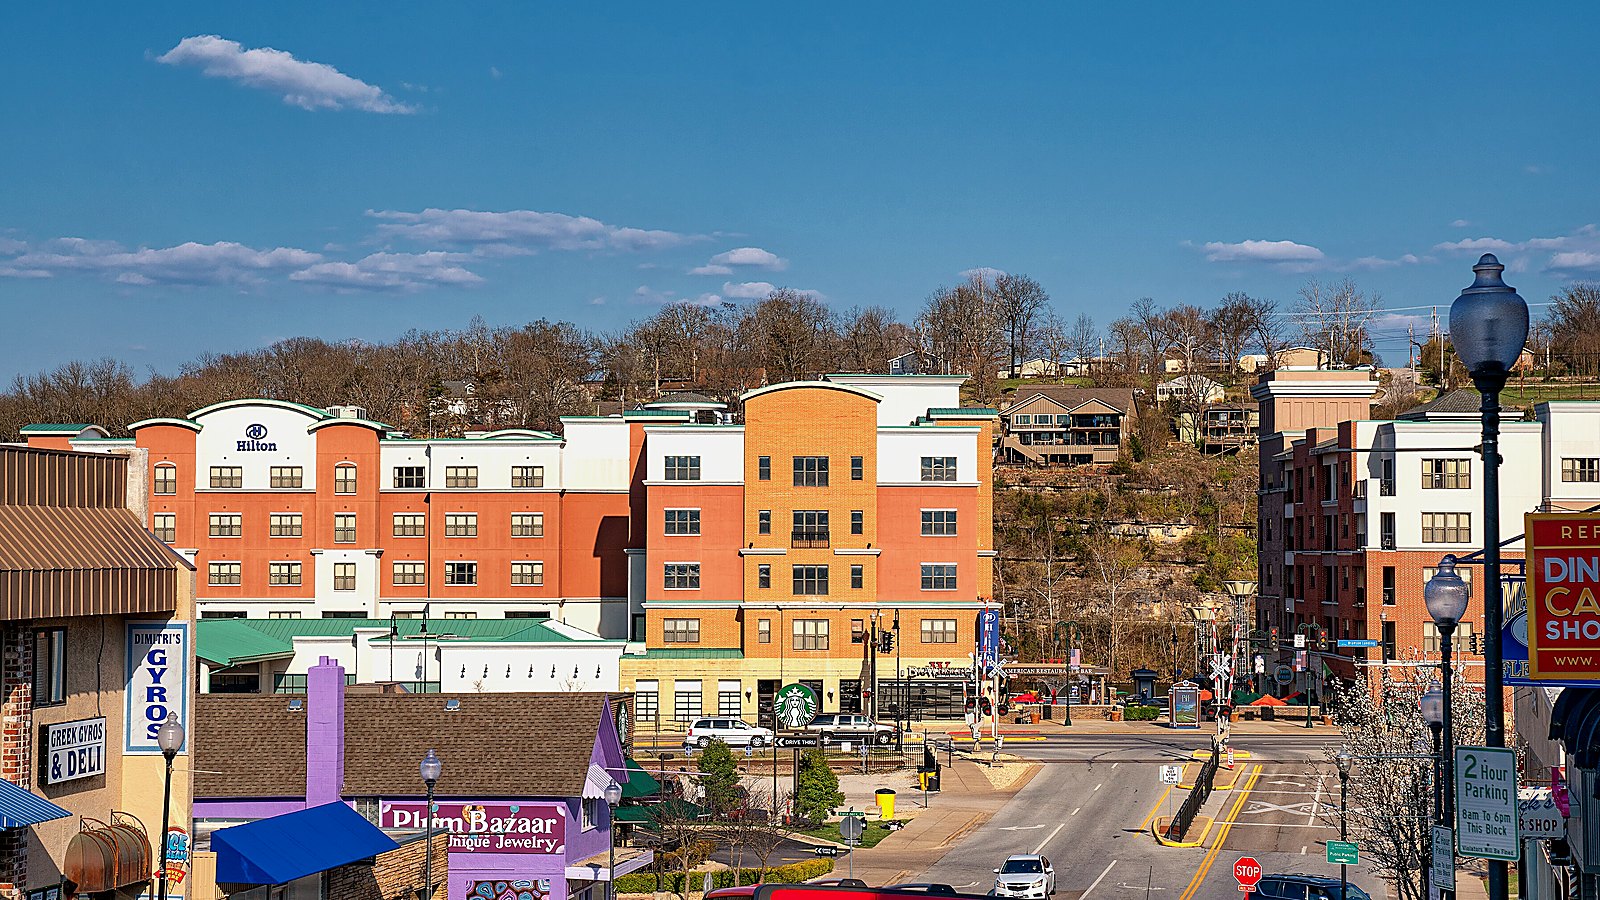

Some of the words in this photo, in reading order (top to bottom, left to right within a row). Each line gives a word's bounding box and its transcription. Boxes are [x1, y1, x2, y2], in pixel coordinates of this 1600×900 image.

[237, 440, 277, 451] Hilton
[1544, 557, 1599, 583] DIN
[1545, 587, 1600, 617] CA
[134, 633, 181, 645] DIMITRI'S
[1545, 620, 1600, 640] SHO
[146, 648, 168, 740] GYROS
[51, 727, 77, 747] GREEK
[78, 723, 103, 742] GYROS
[51, 753, 62, 780] &
[67, 746, 101, 777] DELI
[1464, 754, 1477, 779] 2
[1481, 764, 1508, 781] Hour
[1465, 782, 1508, 805] Parking
[469, 810, 557, 834] Bazaar
[1462, 809, 1479, 820] 8am
[1482, 810, 1491, 821] To
[1494, 812, 1511, 825] 6pm
[1529, 819, 1557, 831] SHOP
[1435, 830, 1440, 844] 2
[1467, 822, 1482, 833] This
[1486, 824, 1507, 836] Block
[496, 836, 558, 852] Jewelry
[166, 850, 187, 860] REAM
[1236, 865, 1260, 877] STOP
